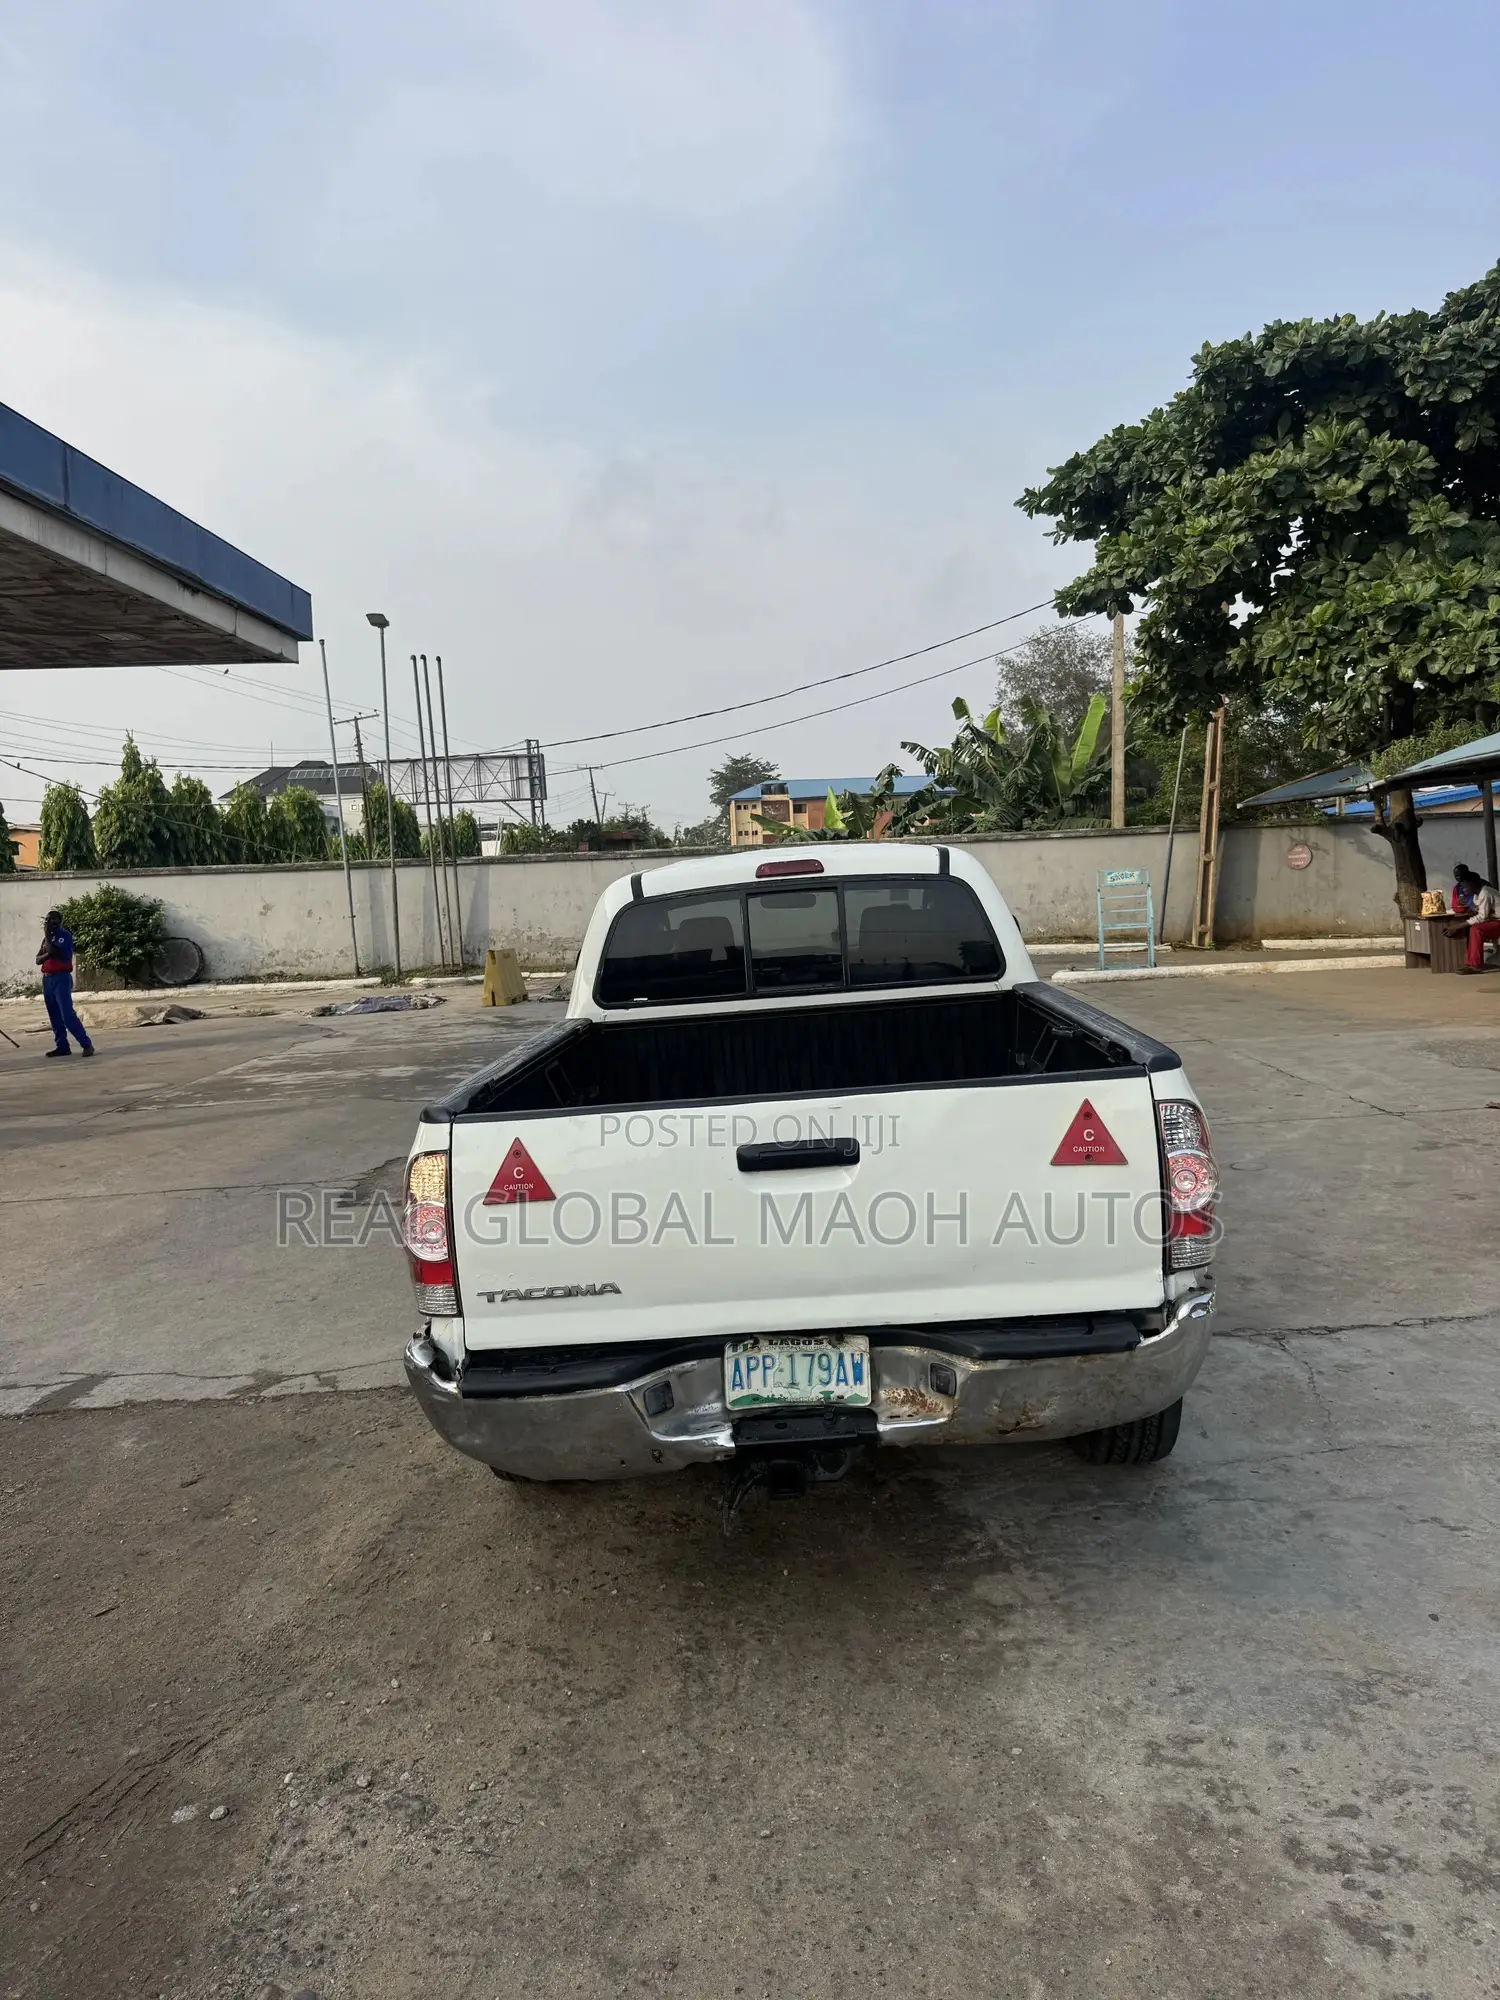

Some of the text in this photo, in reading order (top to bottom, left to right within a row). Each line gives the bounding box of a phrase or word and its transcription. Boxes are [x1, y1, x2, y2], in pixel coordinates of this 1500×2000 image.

[1083, 1128, 1095, 1142] C
[1072, 1145, 1105, 1153] CAUTION
[513, 1166, 524, 1179] C
[476, 1281, 622, 1304] TACOMA
[768, 1338, 825, 1346] LAGOS
